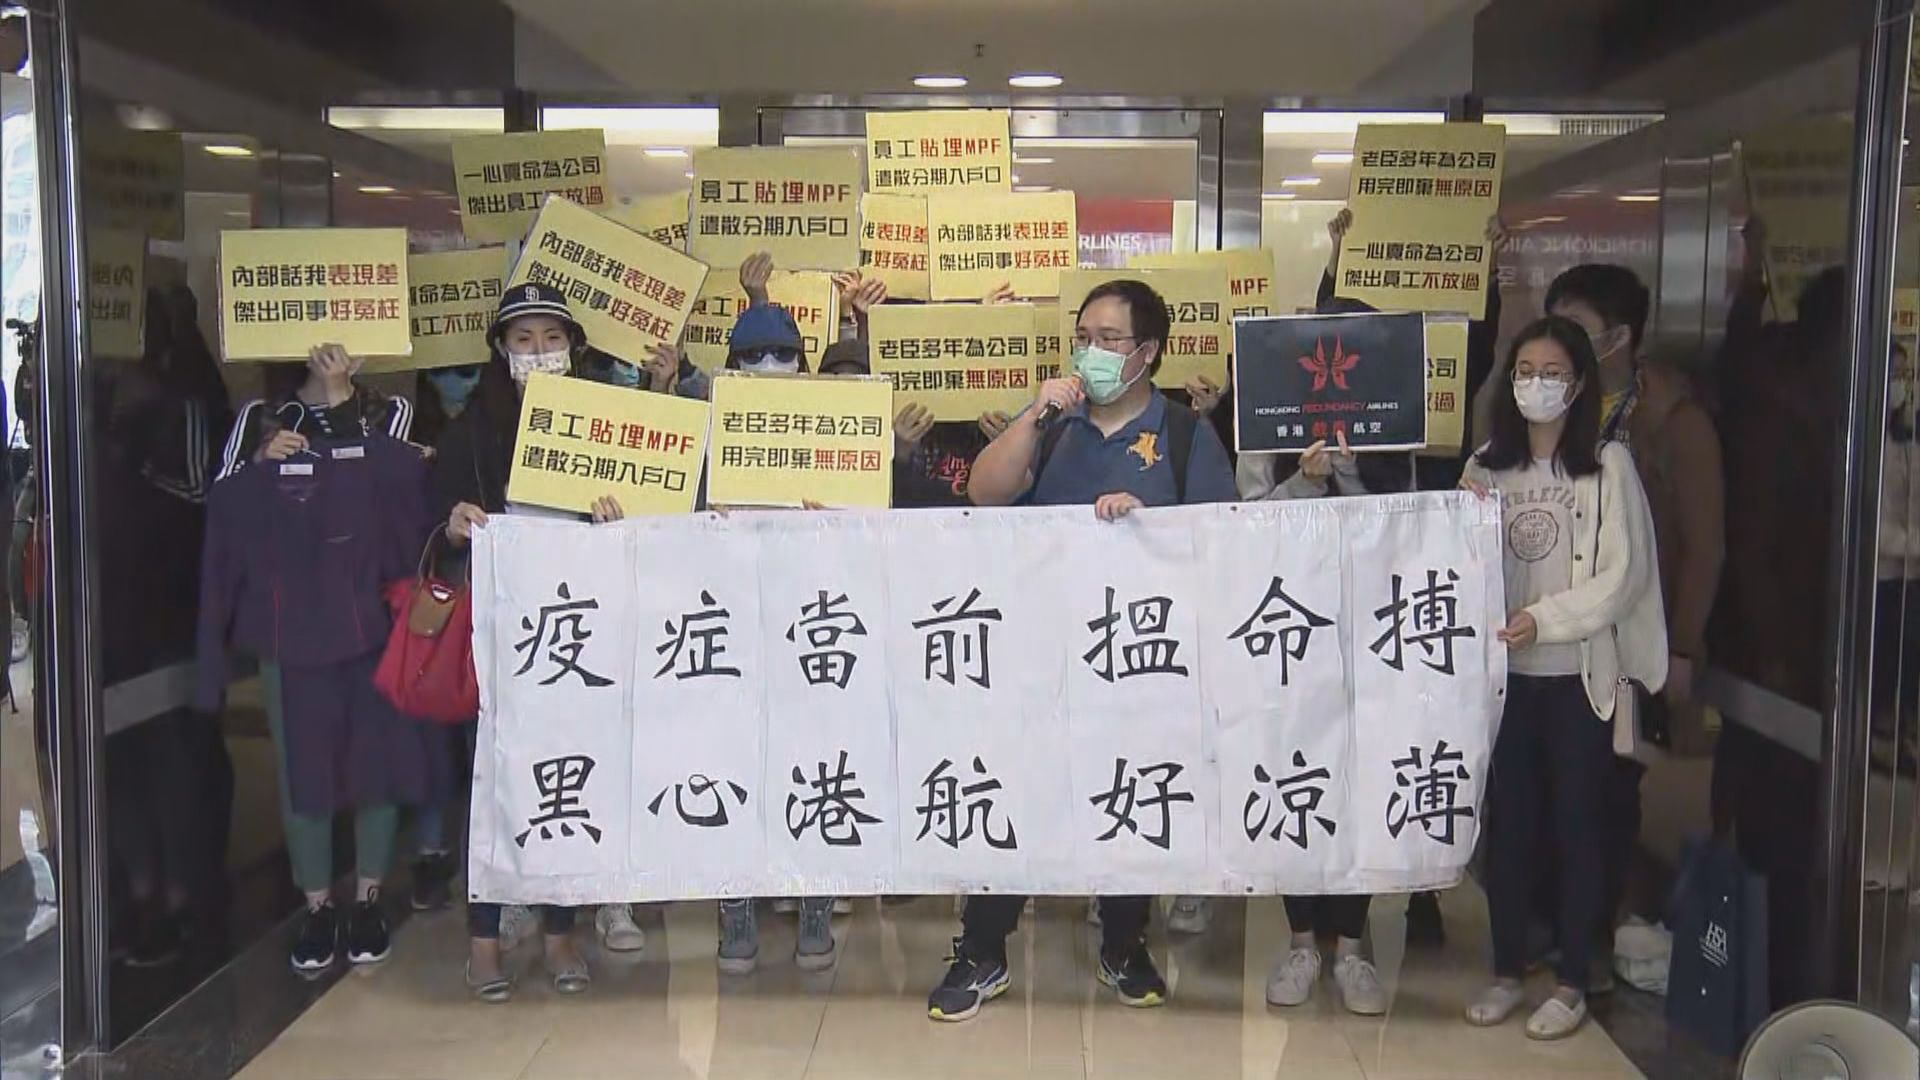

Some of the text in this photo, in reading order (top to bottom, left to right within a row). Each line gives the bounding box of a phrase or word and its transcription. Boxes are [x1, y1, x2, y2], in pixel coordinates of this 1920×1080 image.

[874, 137, 1002, 159] 員工貼埋MPF
[1361, 150, 1497, 169] 老臣多年為公司
[875, 166, 1001, 187] 遣散分期入戶口
[1358, 178, 1492, 197] 用完即棄無原因
[468, 186, 603, 215] 傑出員工放過
[700, 180, 851, 204] 員工貼埋MPF
[700, 214, 848, 236] 遣散分期入戶口
[938, 221, 1069, 243] 內部話我表現差
[939, 249, 1070, 271] 傑出同事好冤枉
[1347, 242, 1484, 263] 一心賣命為公司
[232, 264, 398, 287] 內部話我表現差
[540, 230, 687, 311] 內部話我表現差
[1344, 268, 1480, 291] 傑出員工不放過
[233, 298, 399, 323] 傑出同事好冤枉
[879, 337, 1028, 359] 老臣多年為公司
[527, 407, 695, 455] 員工貼埋MPF
[722, 412, 882, 437] 老臣多年為公司
[521, 444, 687, 491] 遣散分期入戶口
[721, 446, 881, 471] 用完即棄無原因
